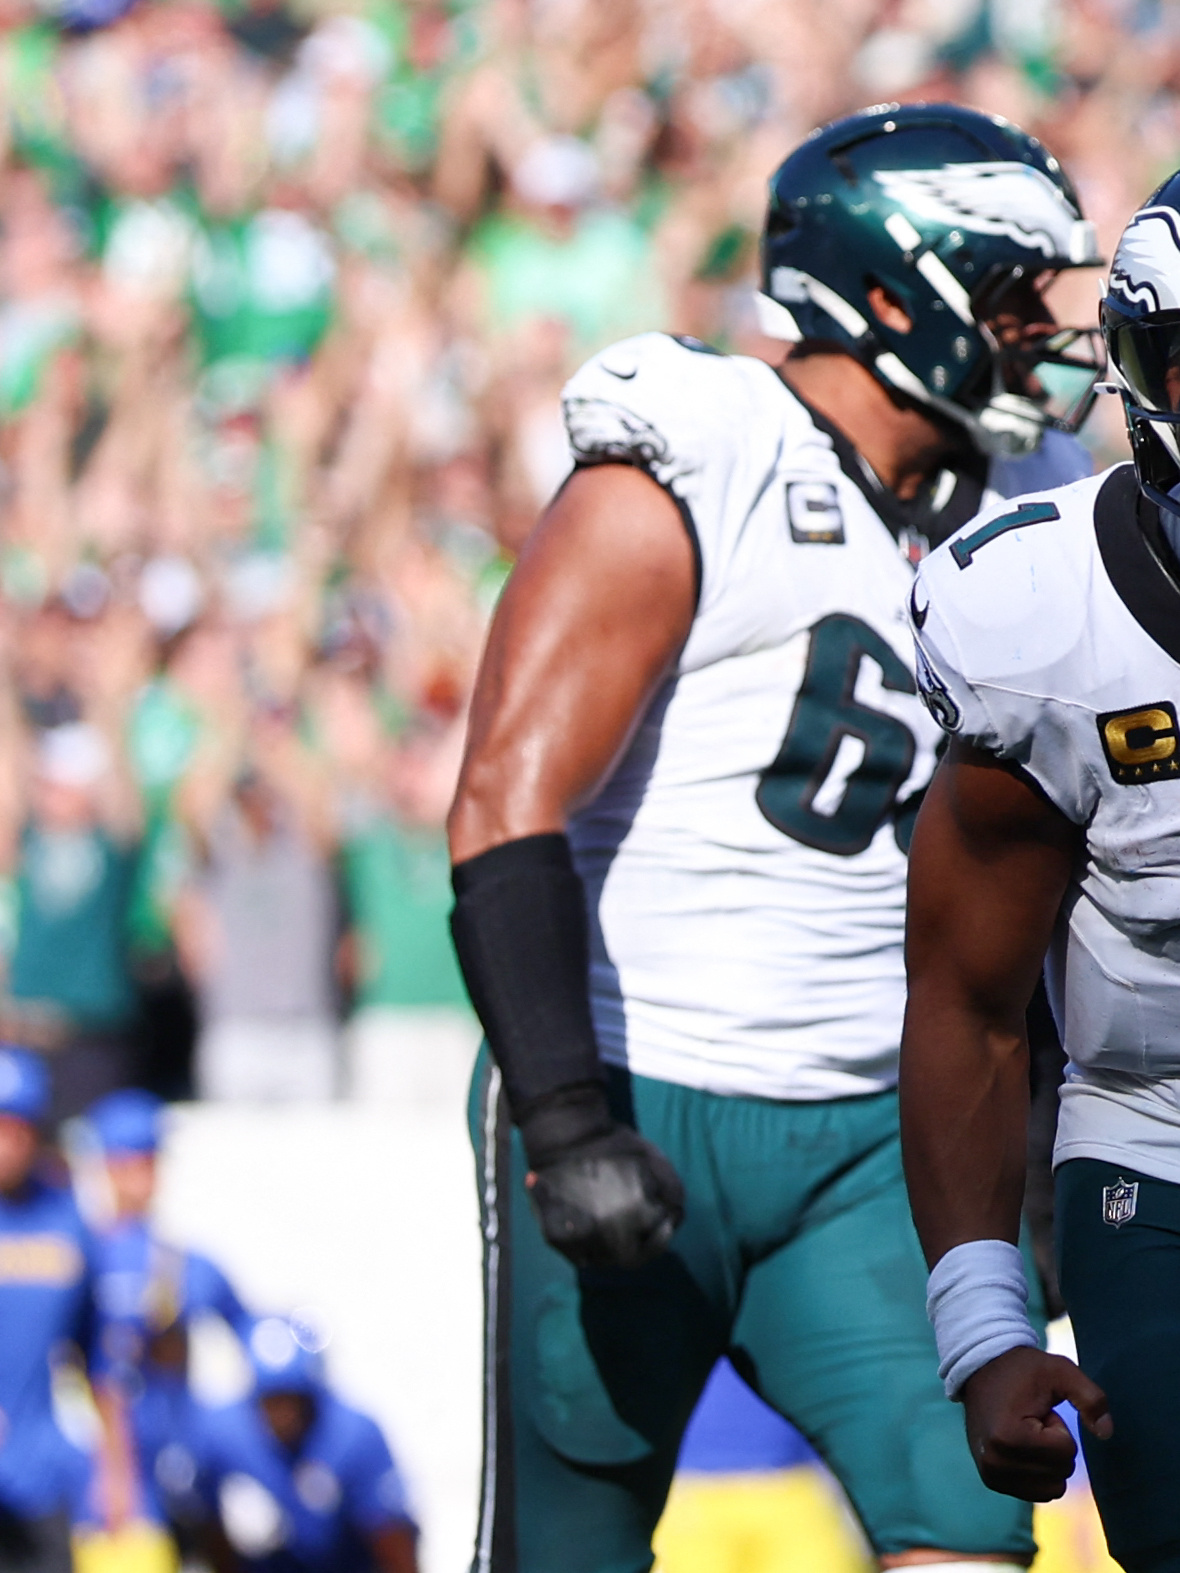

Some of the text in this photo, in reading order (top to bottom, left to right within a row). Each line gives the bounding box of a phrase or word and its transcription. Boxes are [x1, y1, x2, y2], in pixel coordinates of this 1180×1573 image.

[788, 484, 841, 532] C
[950, 502, 1060, 570] 1
[756, 612, 949, 857] 6
[1105, 709, 1176, 765] C
